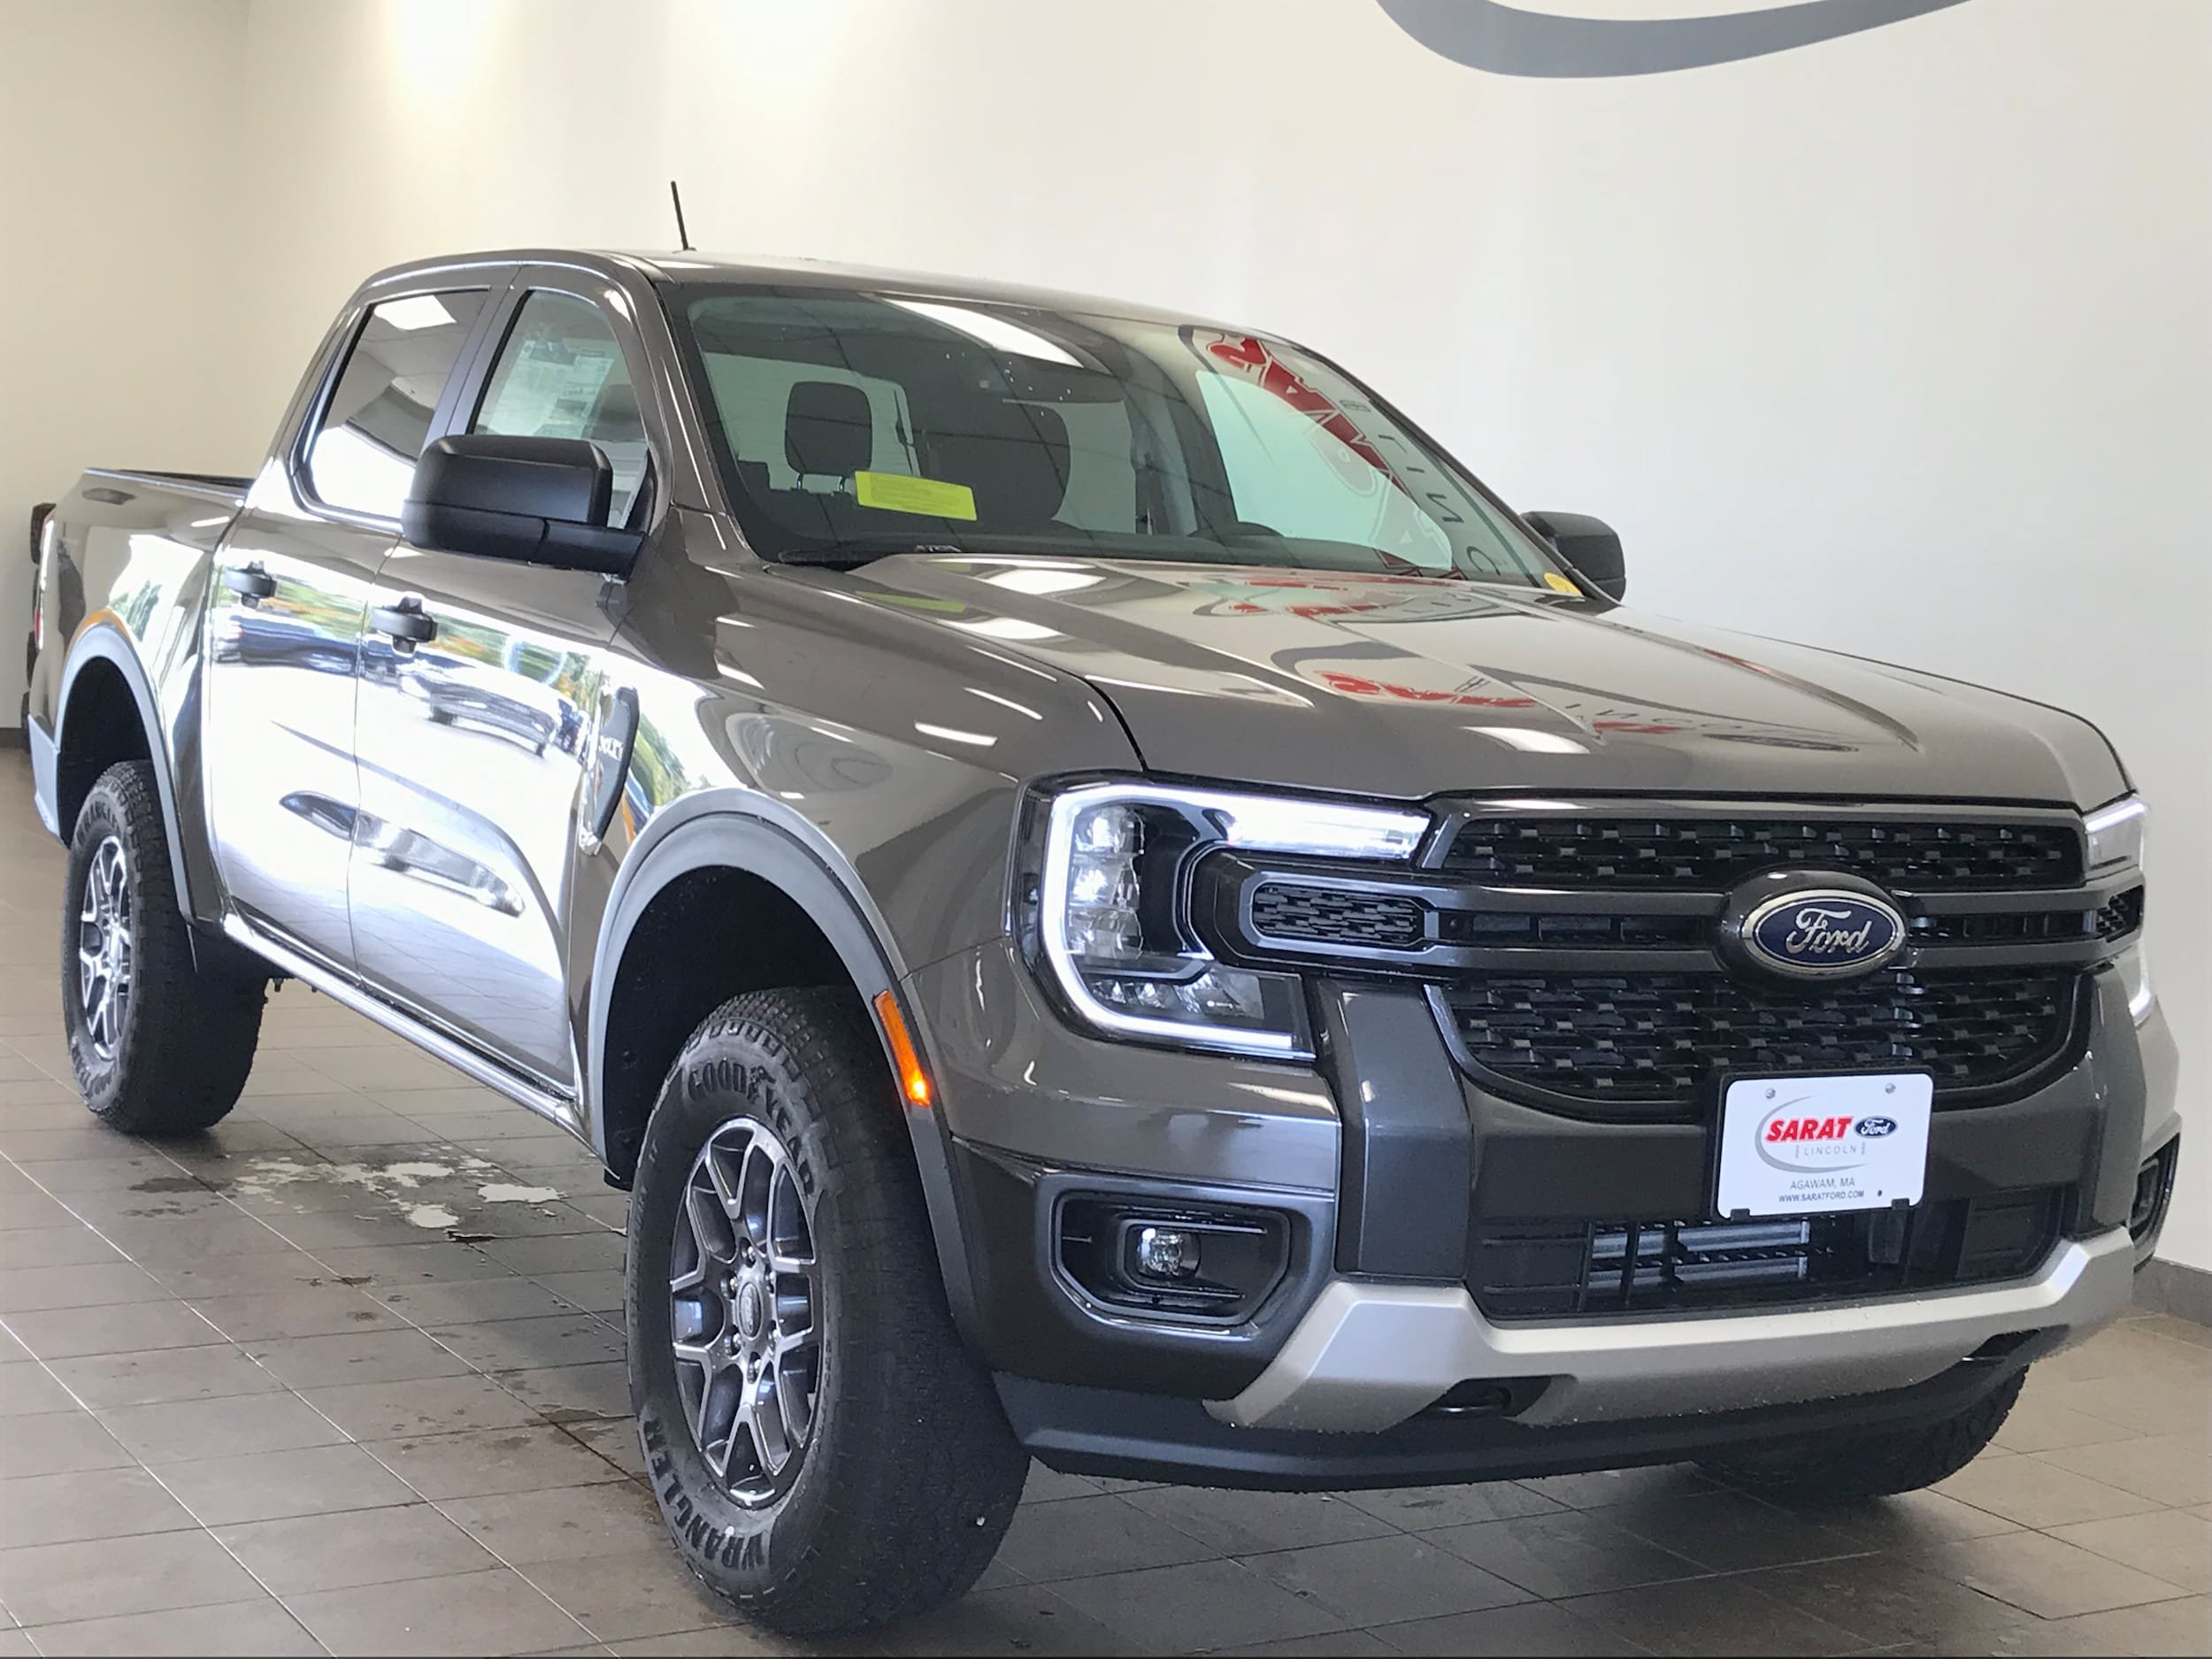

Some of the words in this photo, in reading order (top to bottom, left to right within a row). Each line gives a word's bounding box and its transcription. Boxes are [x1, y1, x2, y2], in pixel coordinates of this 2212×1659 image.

[1786, 908, 1873, 954] Ford
[687, 1059, 815, 1199] GOODYEAR
[1765, 1116, 1855, 1142] SARAT
[1860, 1118, 1891, 1137] Ford
[1803, 1145, 1857, 1156] LINCOLN
[1778, 1190, 1864, 1203] WWW.SARATFORD.COM
[1789, 1179, 1838, 1191] AGAWAM,
[1839, 1177, 1855, 1188] MA
[643, 1417, 765, 1571] WRANGLER
